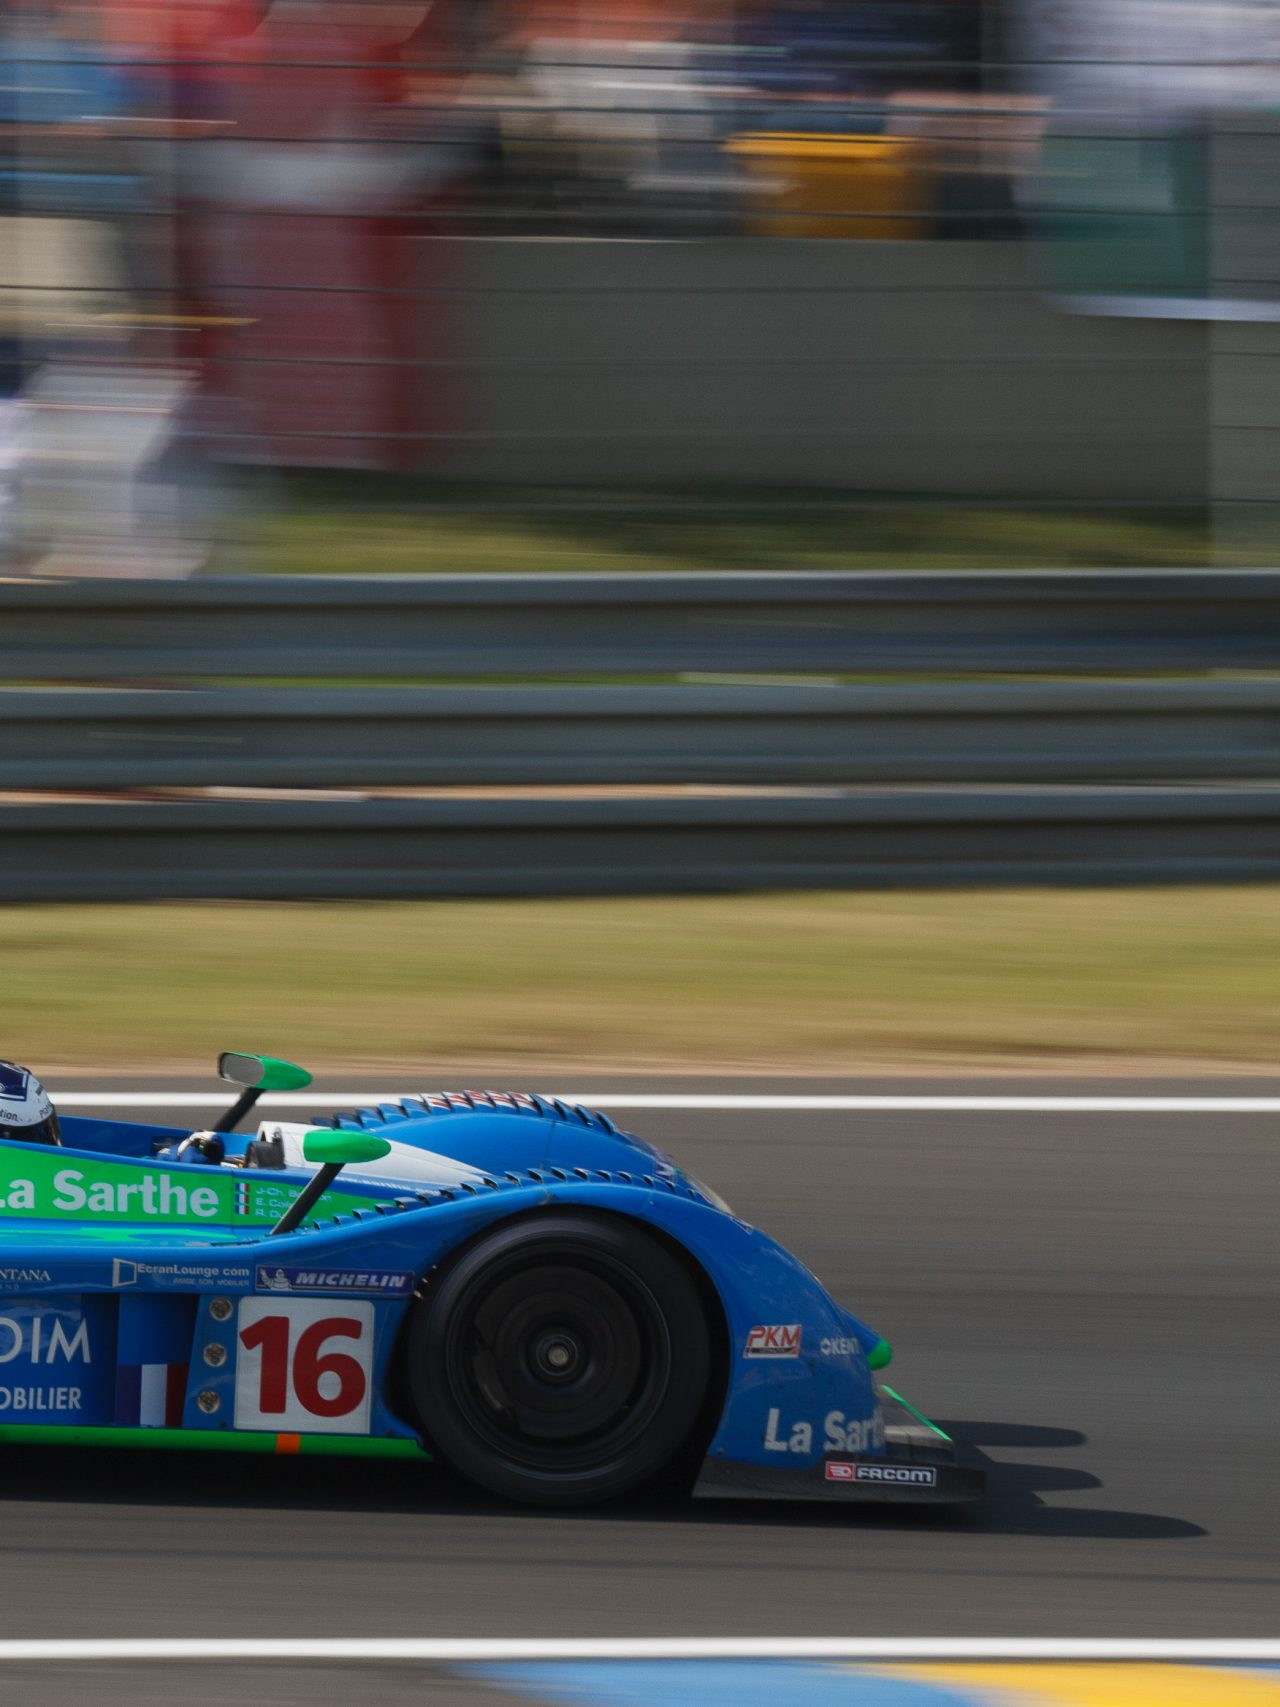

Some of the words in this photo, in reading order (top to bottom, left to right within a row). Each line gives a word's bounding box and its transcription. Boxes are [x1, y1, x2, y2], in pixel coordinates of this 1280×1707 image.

[52, 1170, 219, 1217] Sarthe
[295, 1272, 406, 1288] MICHELIN
[748, 1326, 801, 1347] PKM
[239, 1315, 366, 1418] 16
[764, 1408, 812, 1454] La
